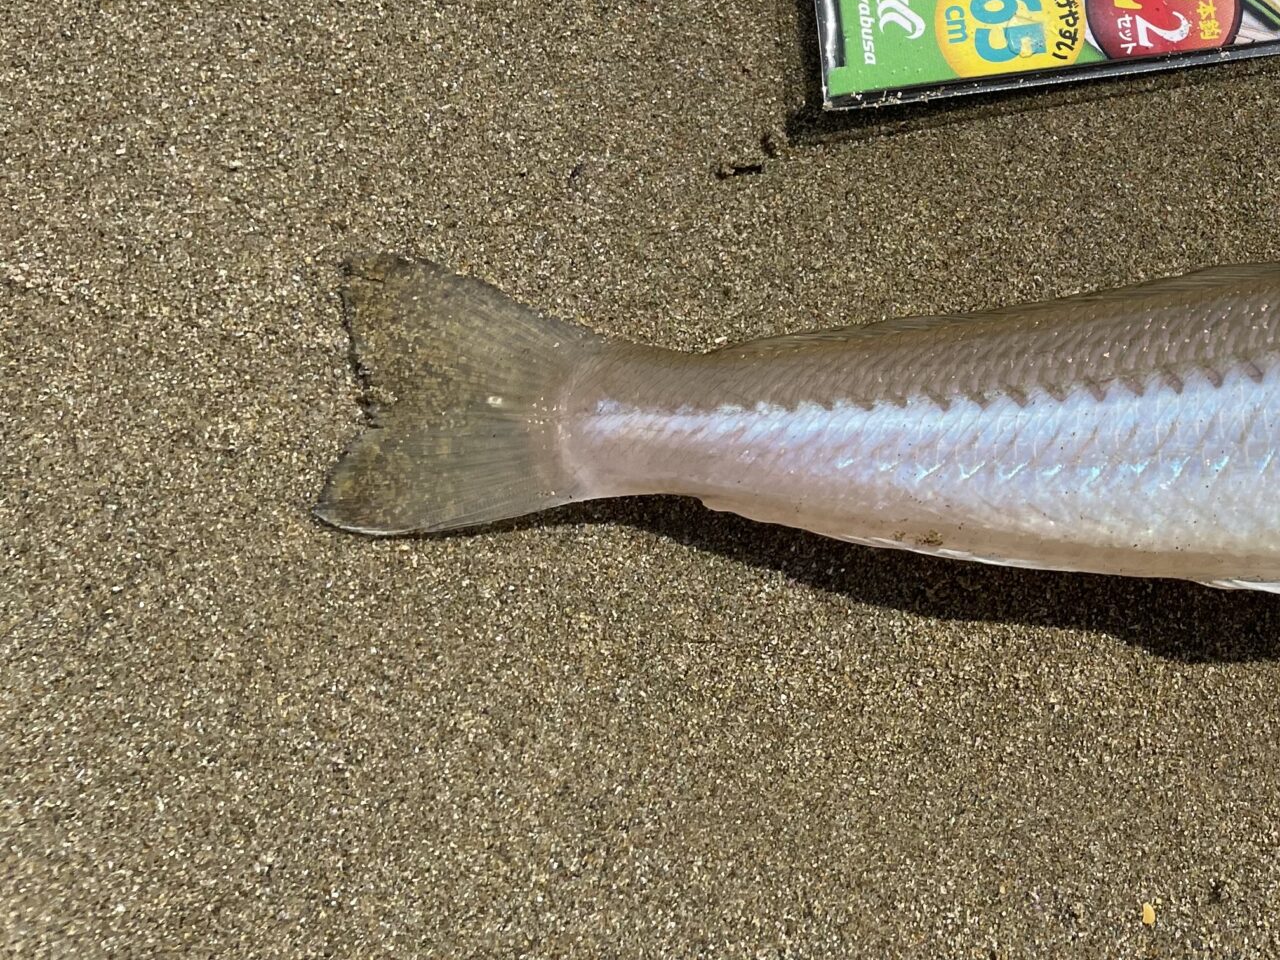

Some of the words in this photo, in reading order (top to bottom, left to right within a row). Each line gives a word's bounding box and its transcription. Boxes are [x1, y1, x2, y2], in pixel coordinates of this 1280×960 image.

[944, 5, 969, 45] cm
[1117, 15, 1139, 56] セット
